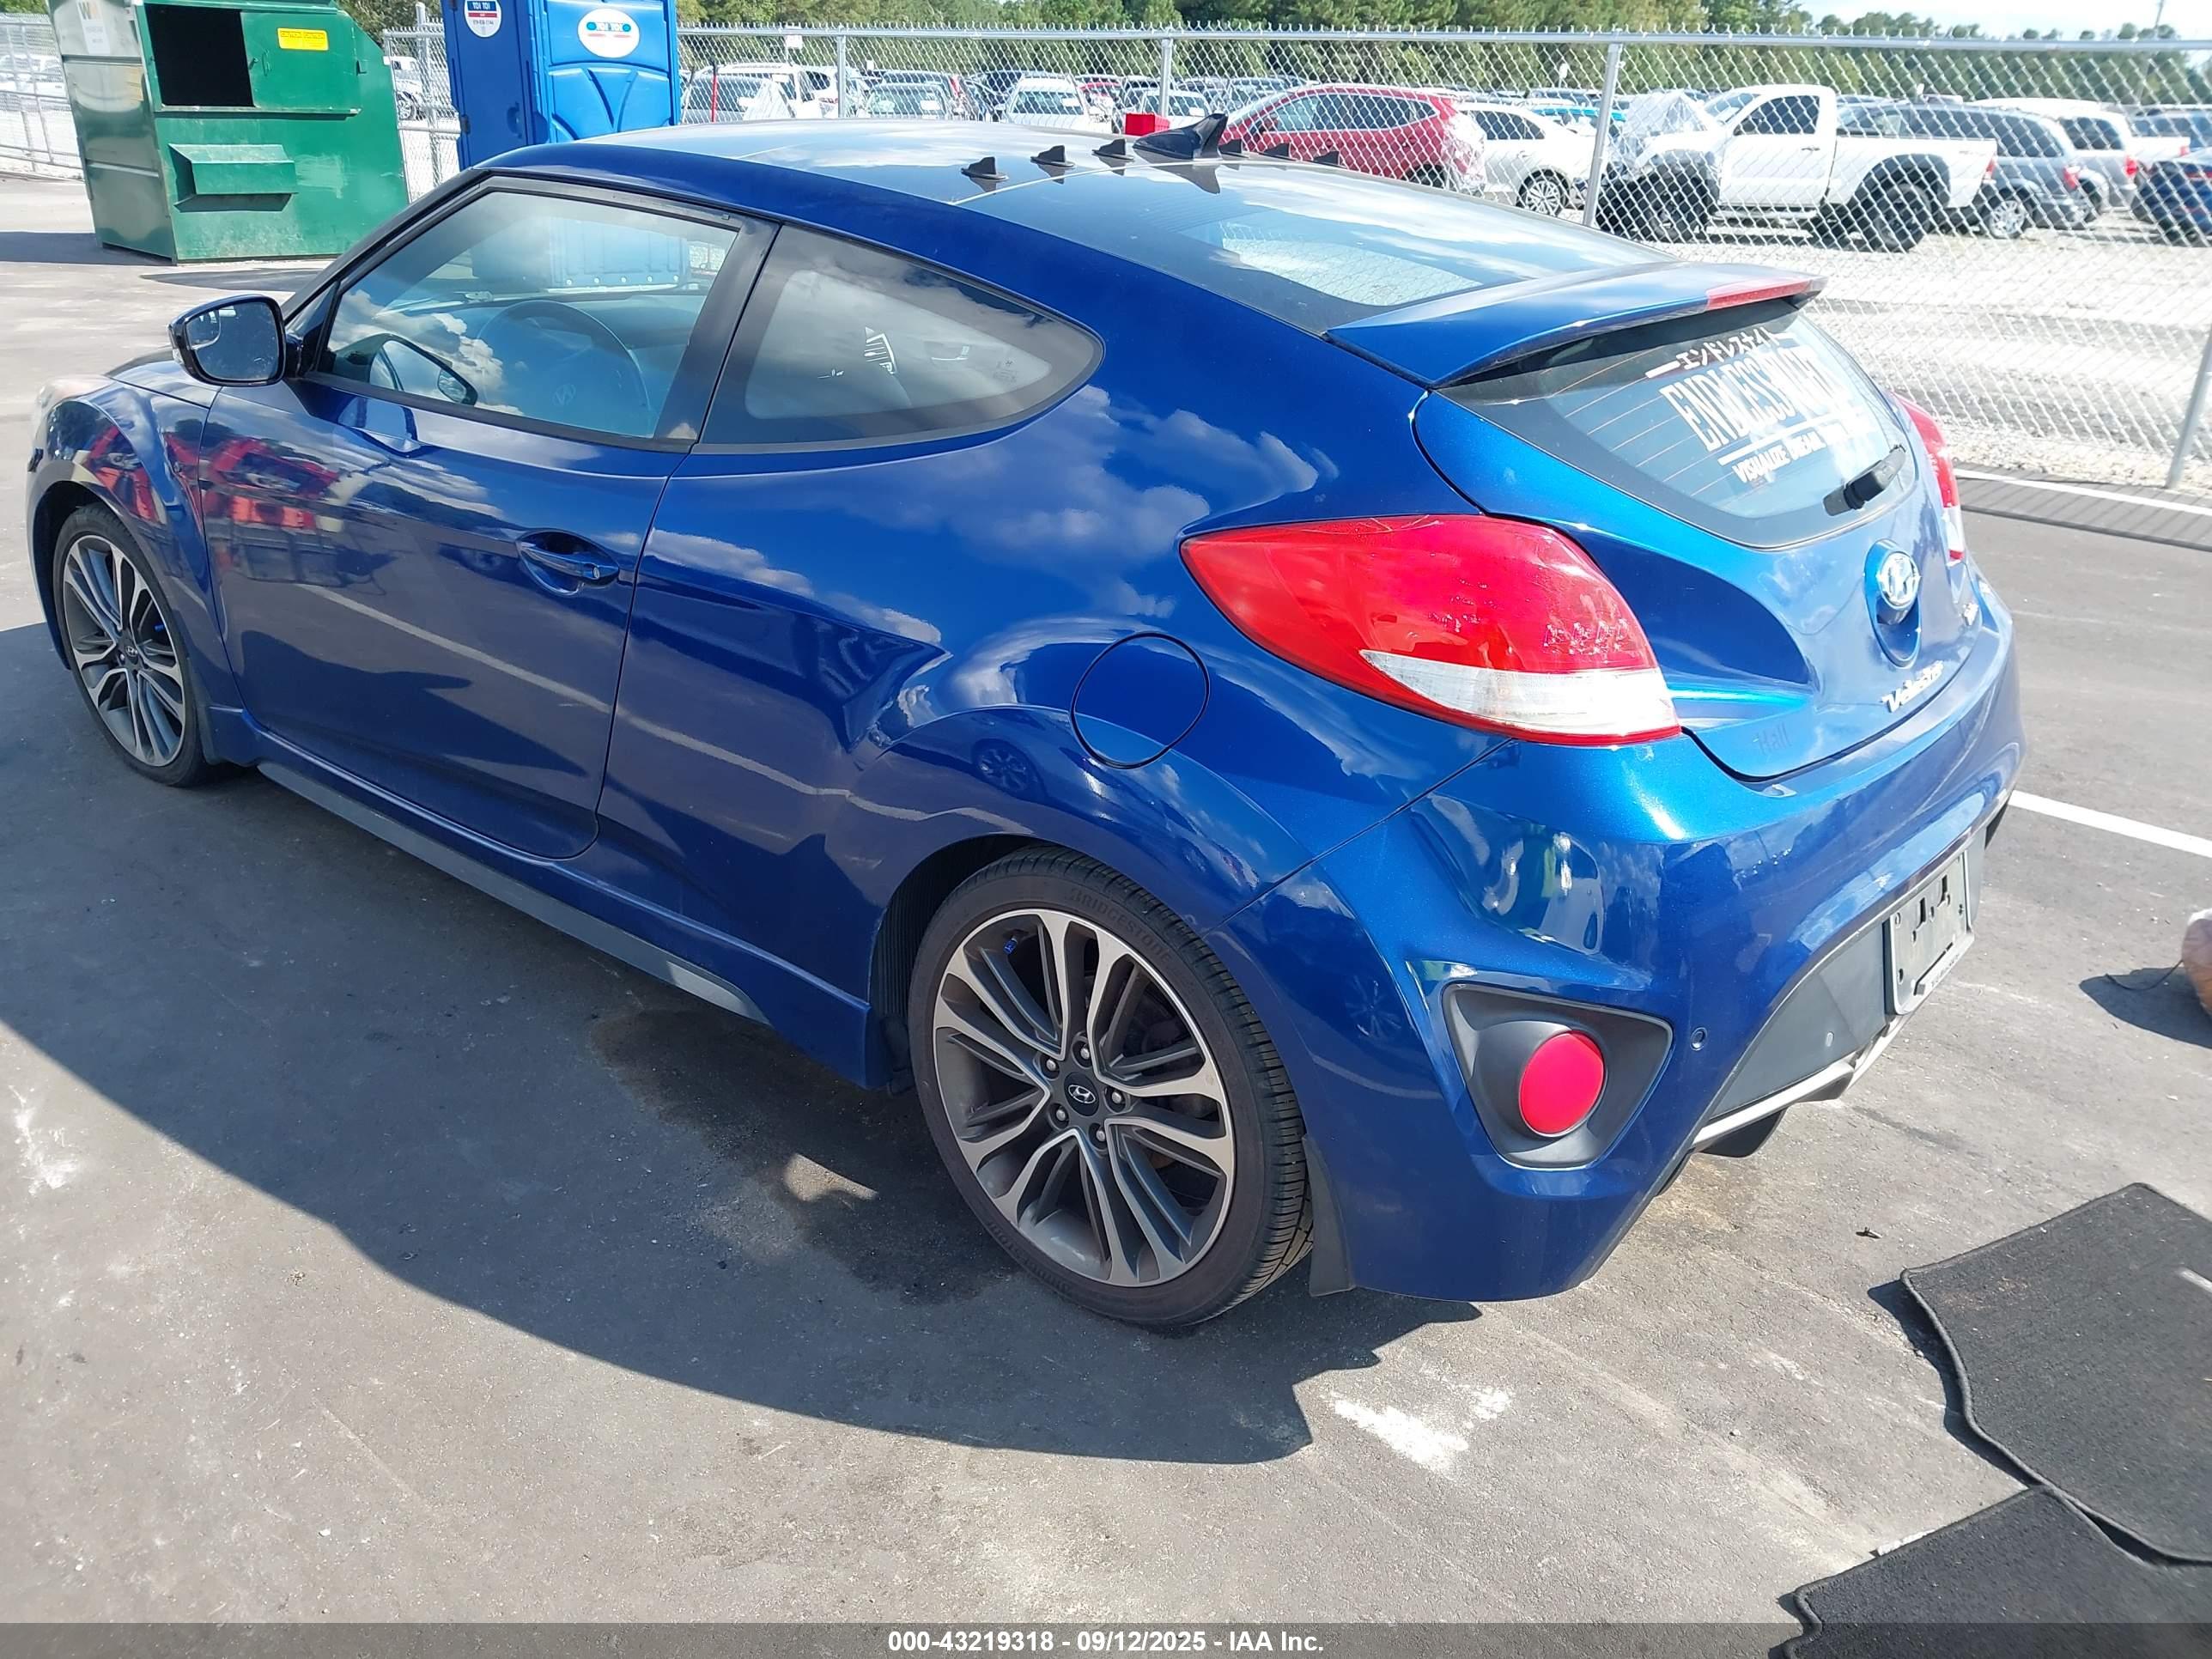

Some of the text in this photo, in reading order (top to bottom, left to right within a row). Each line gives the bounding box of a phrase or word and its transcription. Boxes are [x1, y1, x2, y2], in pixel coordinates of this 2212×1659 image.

[1676, 326, 1779, 370] エンドレスナイト
